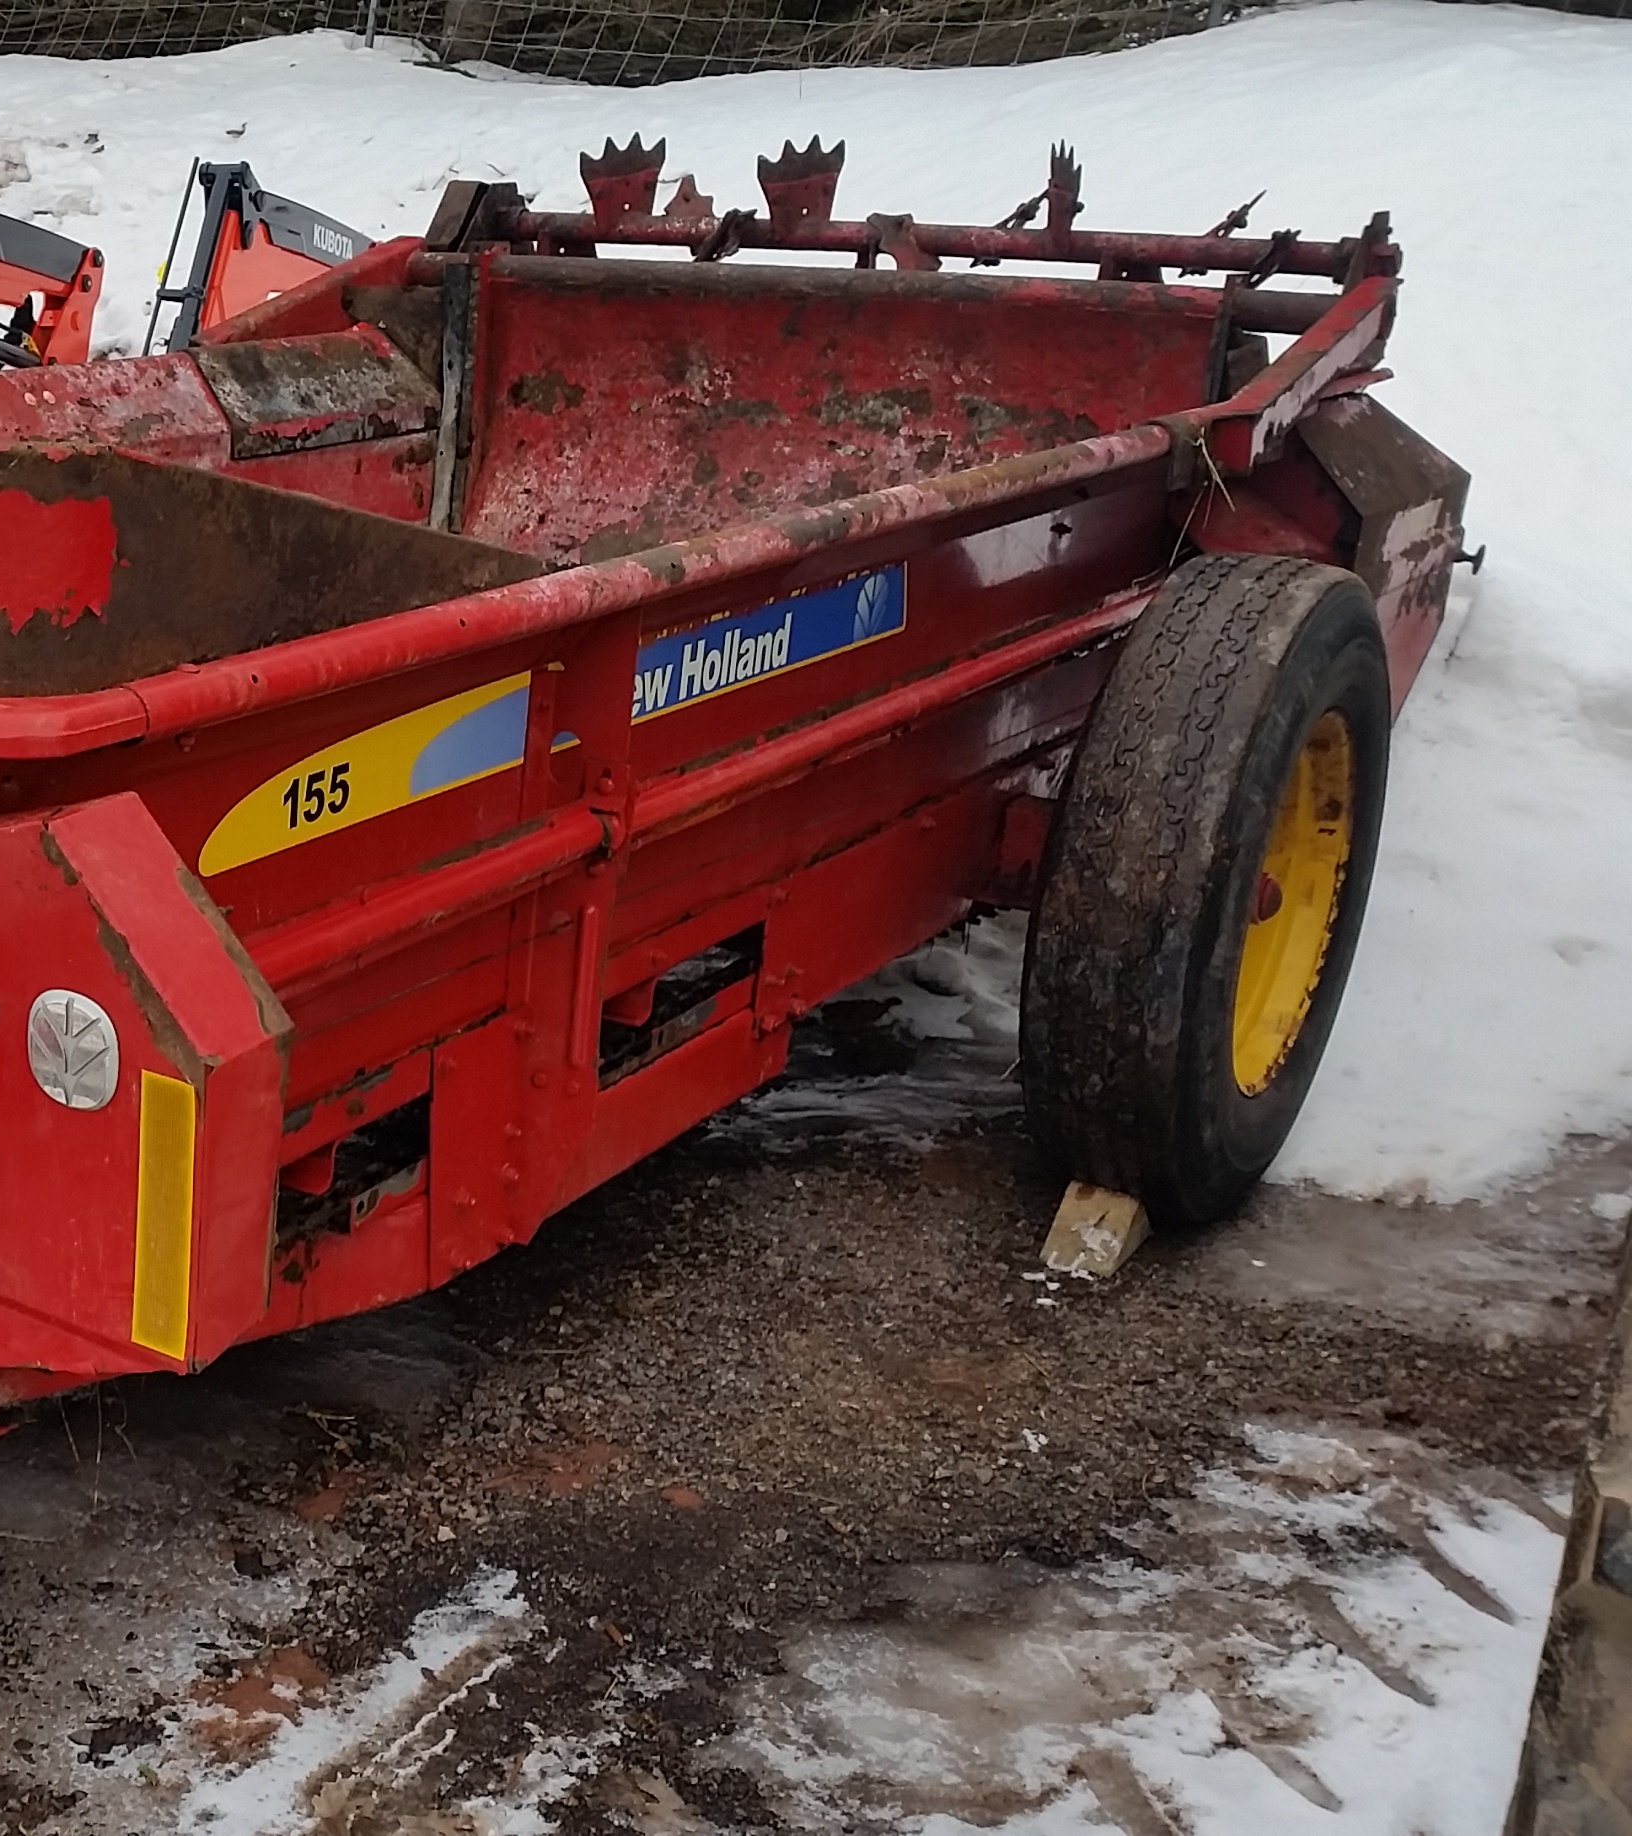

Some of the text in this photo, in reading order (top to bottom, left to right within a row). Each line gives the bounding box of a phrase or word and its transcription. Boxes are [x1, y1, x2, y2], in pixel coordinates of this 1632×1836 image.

[313, 223, 353, 260] KUBOTA
[631, 612, 793, 718] ew Holland
[283, 762, 350, 829] 155
